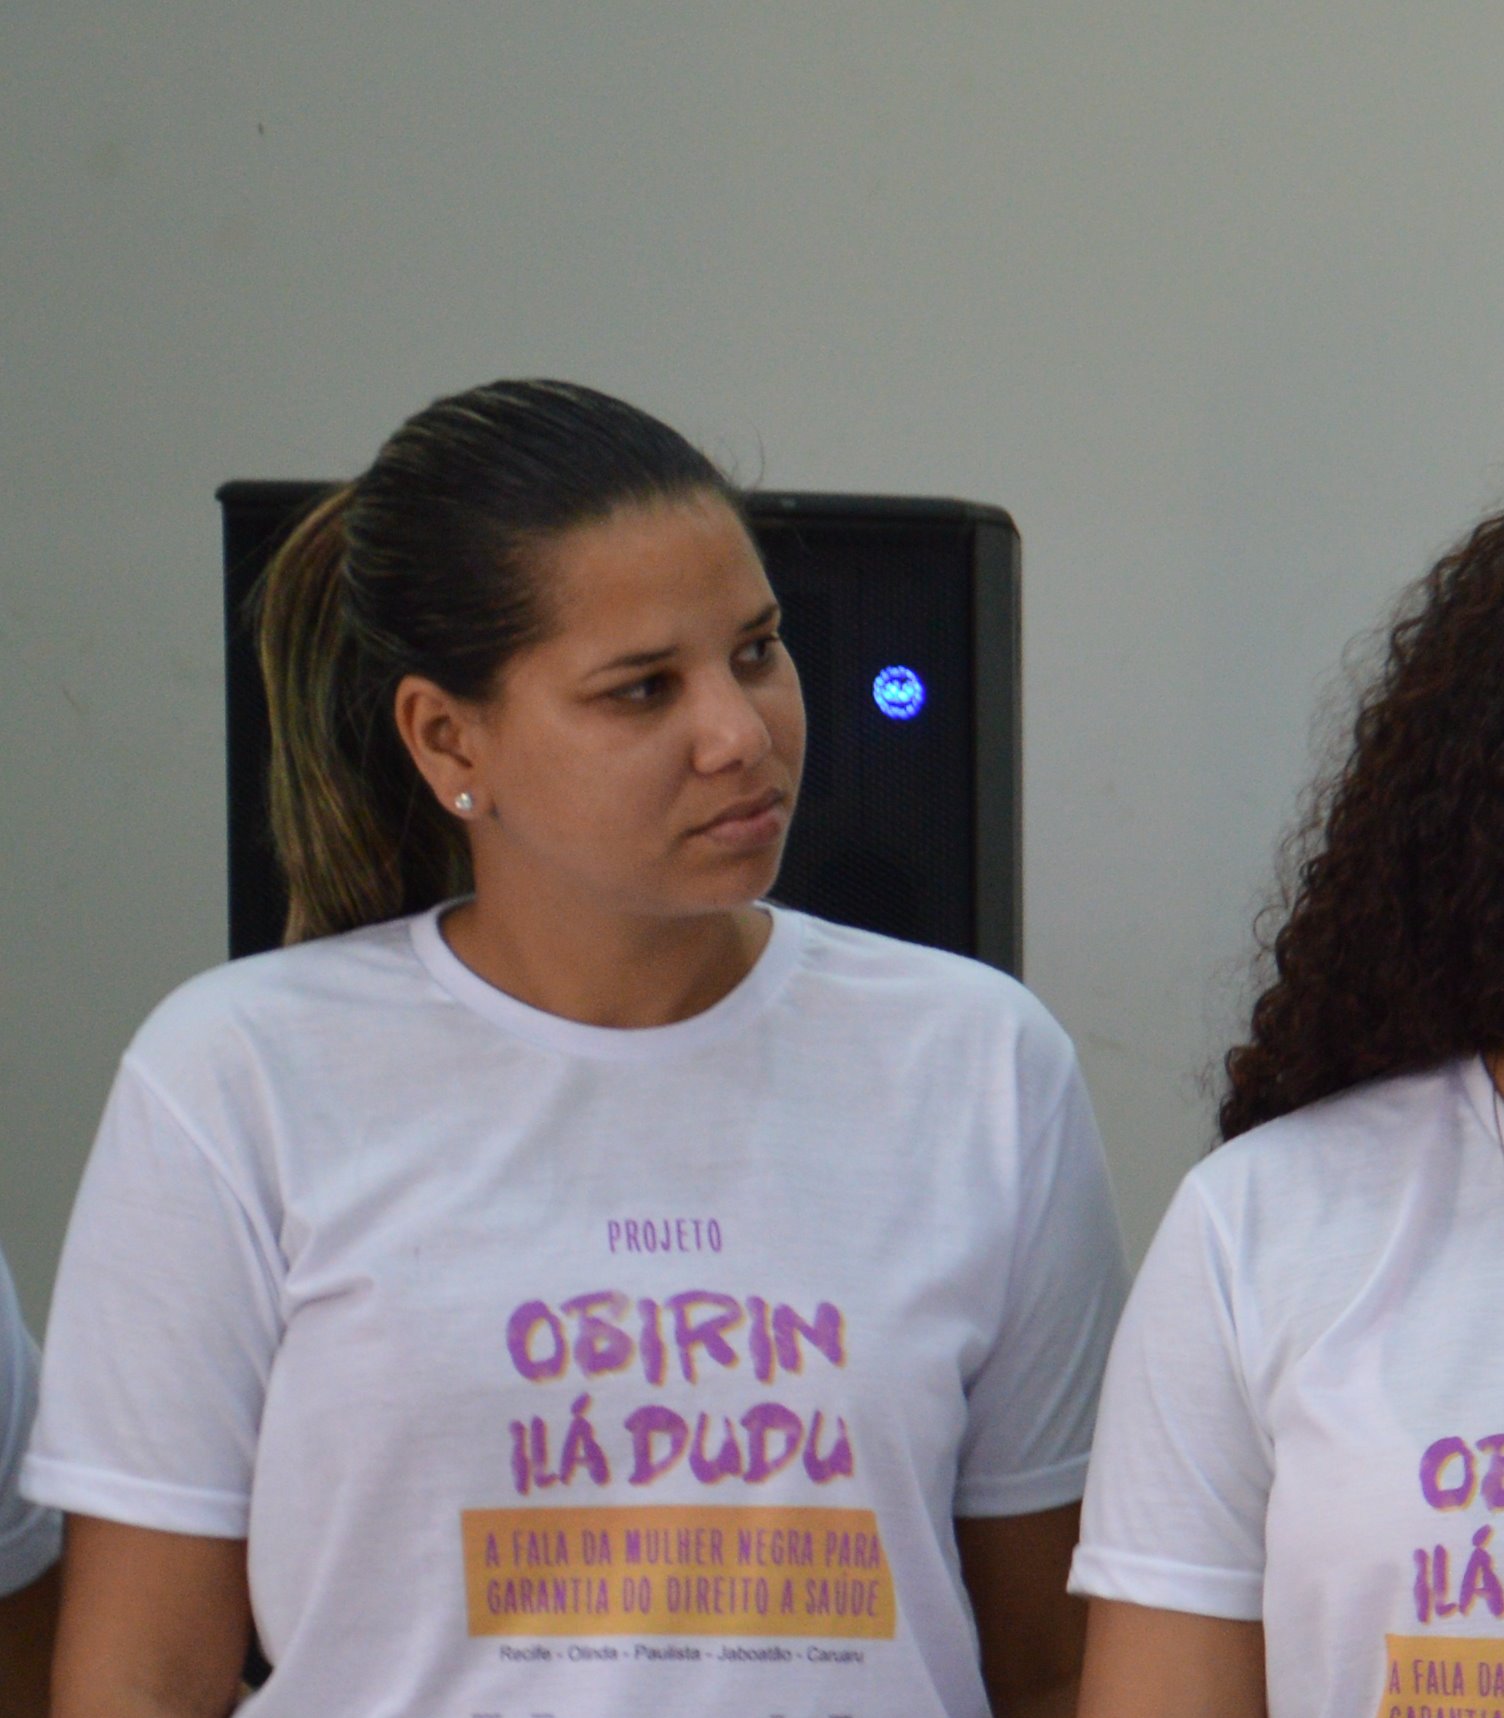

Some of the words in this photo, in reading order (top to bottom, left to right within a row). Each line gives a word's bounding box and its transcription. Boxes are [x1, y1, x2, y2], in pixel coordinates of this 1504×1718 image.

[608, 1218, 723, 1253] PROJETO
[506, 1289, 846, 1387] OBIRIN
[509, 1392, 611, 1496] ILÁ
[625, 1402, 855, 1486] DUDU
[485, 1530, 499, 1568] A
[512, 1529, 569, 1568] FALA
[582, 1528, 612, 1567] DA
[625, 1528, 724, 1567] MULHER
[738, 1529, 815, 1568] NEGRA
[825, 1531, 881, 1570] PARA
[487, 1576, 609, 1615] GARANTIA
[622, 1576, 652, 1615] DO
[666, 1576, 769, 1615] DIREITO
[780, 1578, 795, 1615] A
[805, 1570, 880, 1618] SAÚDE
[500, 1645, 551, 1662] Recife
[568, 1645, 619, 1662] Olinda
[634, 1644, 701, 1662] Paulista
[807, 1646, 865, 1663] Caruaru
[1388, 1660, 1401, 1696] A
[1412, 1659, 1465, 1697] FALA
